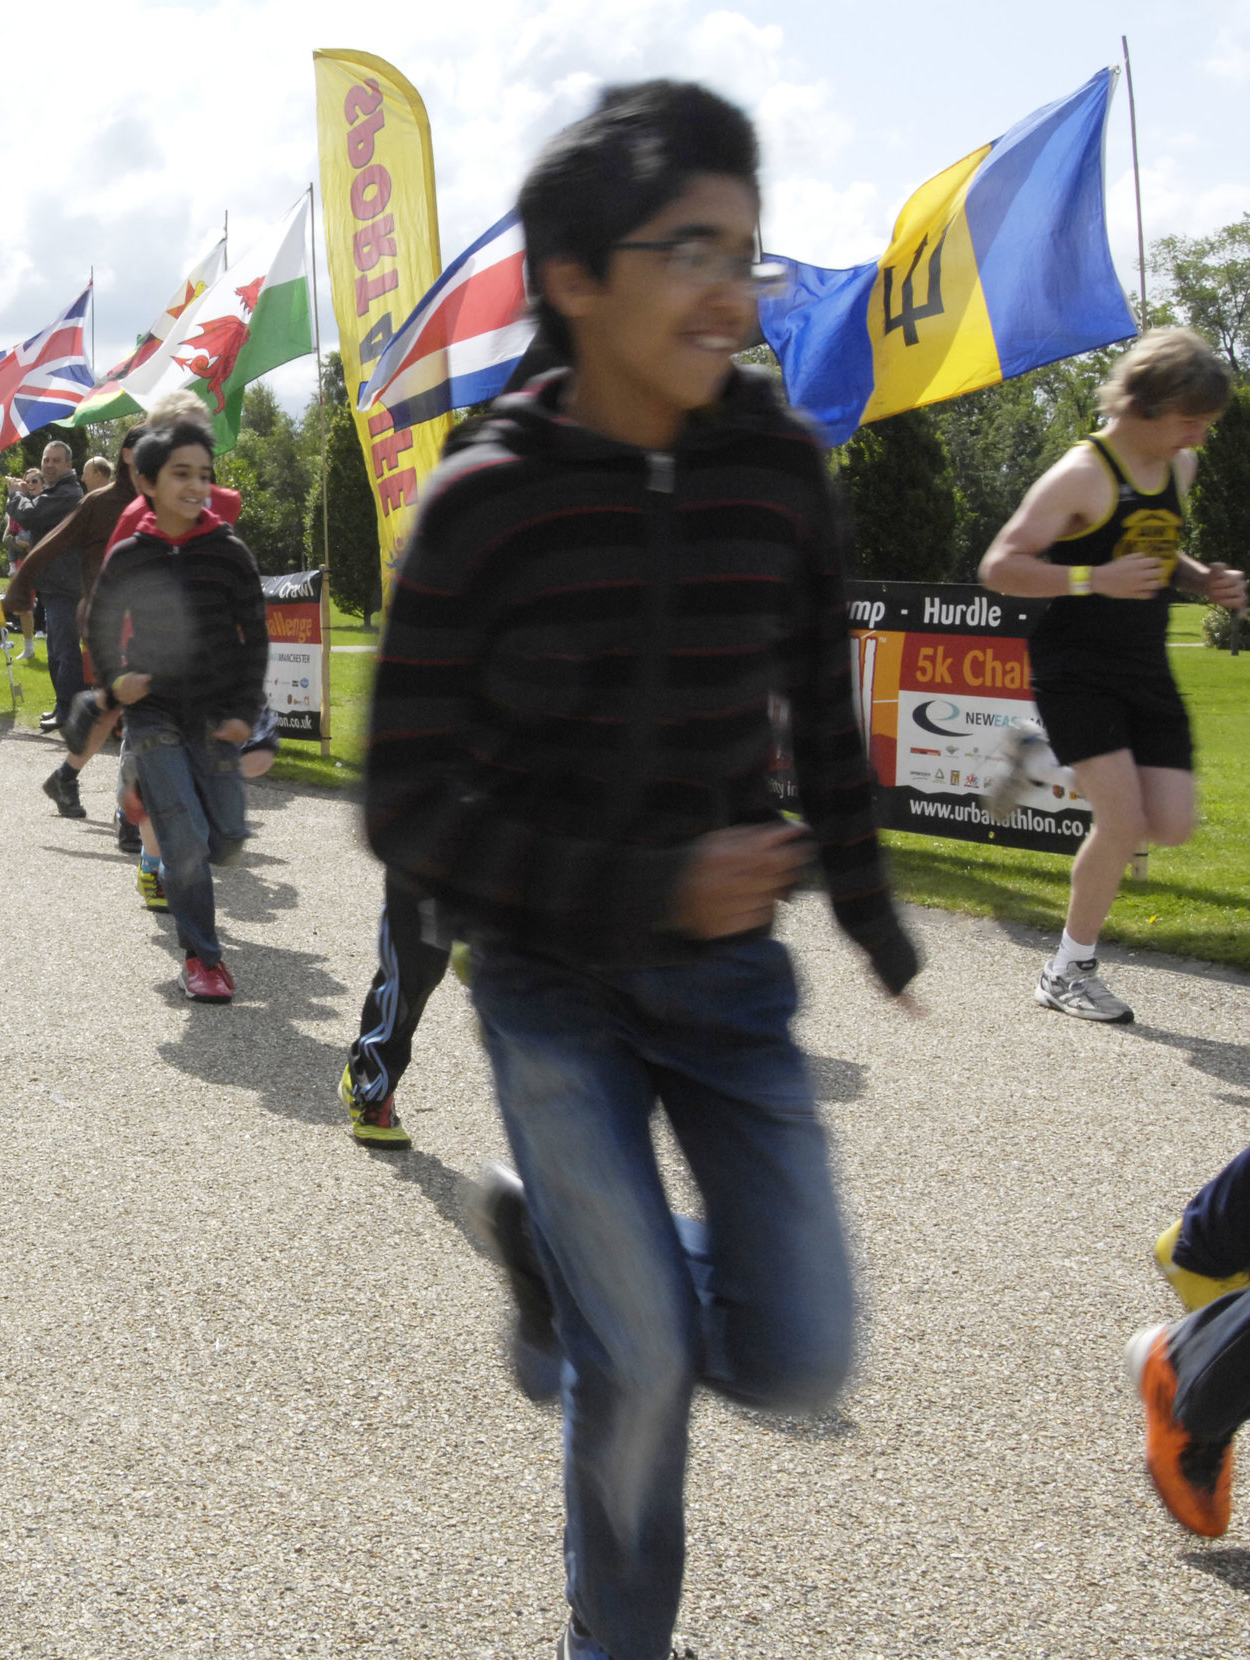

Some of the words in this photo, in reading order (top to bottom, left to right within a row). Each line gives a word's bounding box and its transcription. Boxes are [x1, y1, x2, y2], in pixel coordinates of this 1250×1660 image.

[278, 577, 314, 599] Crawl
[849, 600, 886, 629] mp
[923, 596, 1001, 627] Hurdle
[915, 645, 953, 684] 5k
